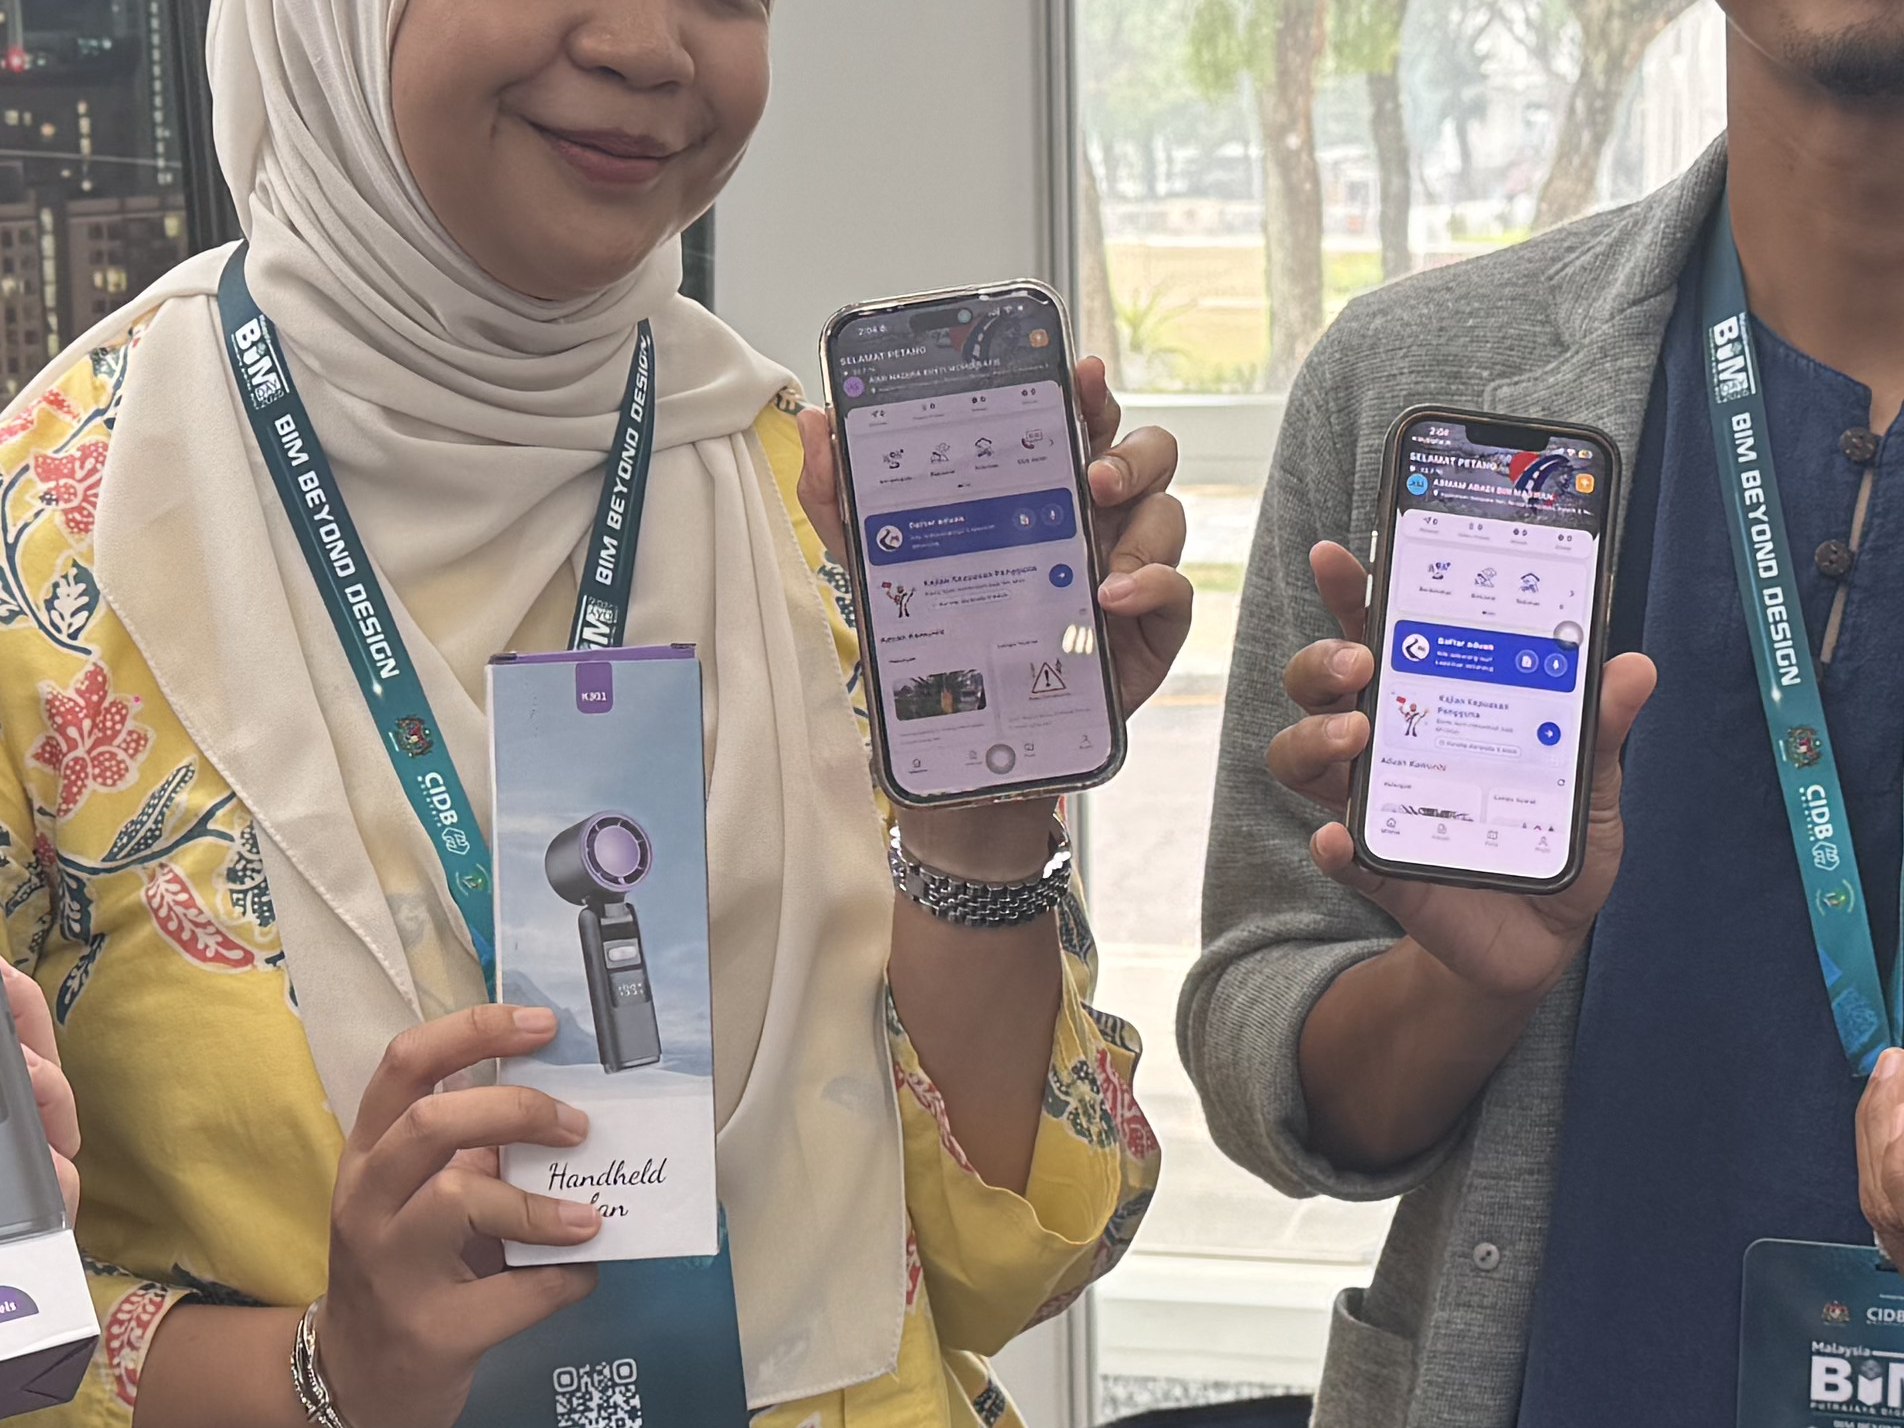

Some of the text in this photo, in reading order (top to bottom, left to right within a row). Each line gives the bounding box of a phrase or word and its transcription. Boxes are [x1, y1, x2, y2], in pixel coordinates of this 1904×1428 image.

[630, 334, 651, 423] DESIGN
[606, 427, 640, 530] BEYOND
[1409, 452, 1456, 467] SELAMAT
[274, 413, 400, 679] BIM BEYOND DESIGN
[595, 535, 619, 586] BIM
[1731, 412, 1801, 686] BIM BEYOND DESIGN
[425, 772, 458, 826] CIDB
[1806, 784, 1834, 841] CIDB
[548, 1157, 667, 1191] Handheld
[1811, 1340, 1872, 1357] Malaysia
